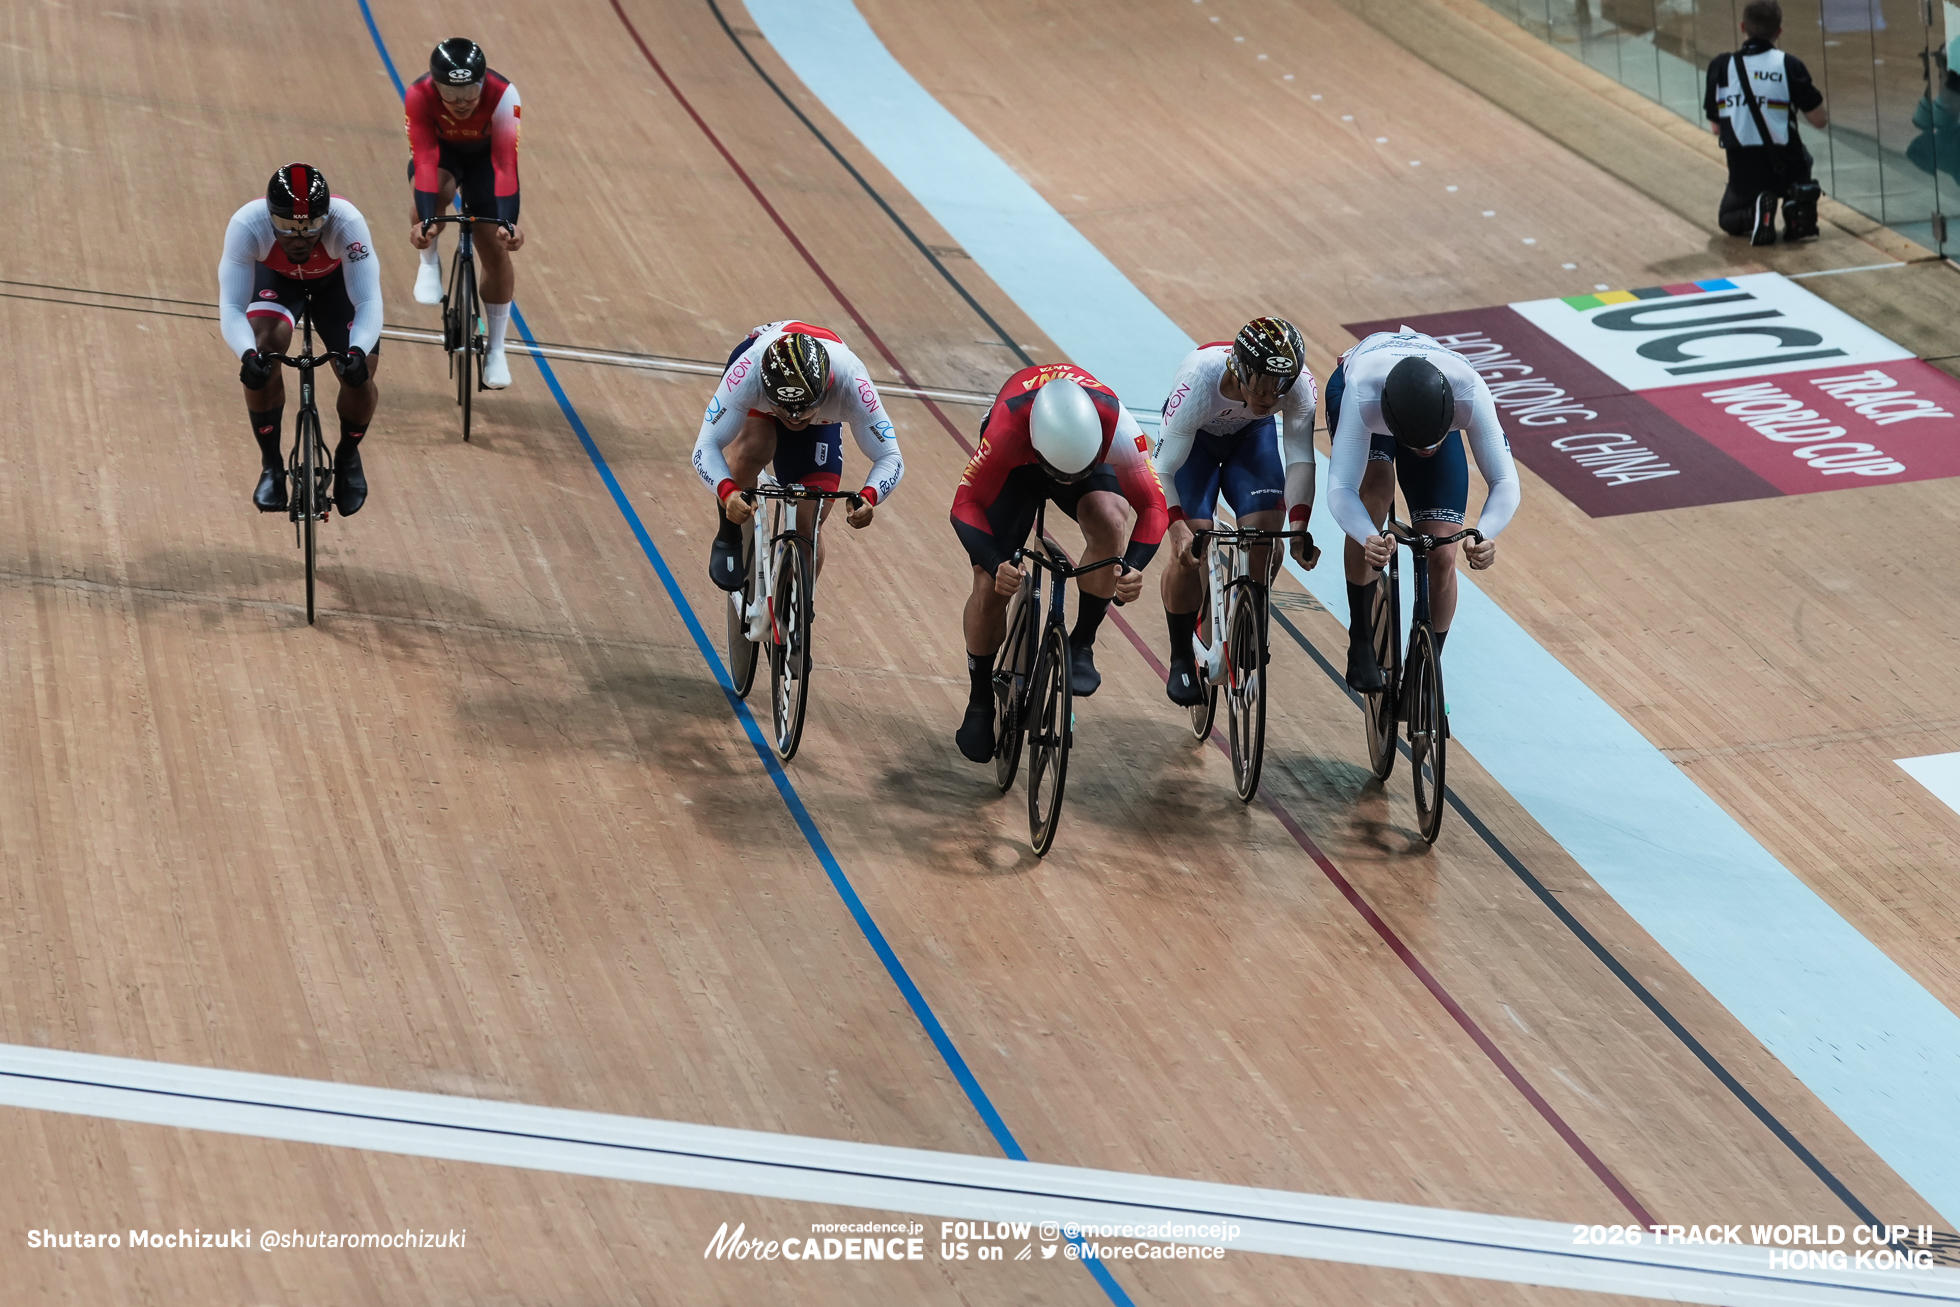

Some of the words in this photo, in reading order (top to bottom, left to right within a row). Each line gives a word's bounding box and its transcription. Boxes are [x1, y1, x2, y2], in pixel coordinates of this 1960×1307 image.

[1726, 94, 1766, 108] STF
[1759, 71, 1783, 83] UCI
[1591, 292, 1848, 376] UCI
[1039, 365, 1074, 373] ANTA
[1809, 369, 1955, 426] TRACK
[1488, 376, 1598, 426] KONG
[1551, 432, 1681, 487] CHINA
[1701, 381, 1848, 443] WORLD
[1792, 442, 1907, 477] CUP
[958, 437, 993, 489] CHINA
